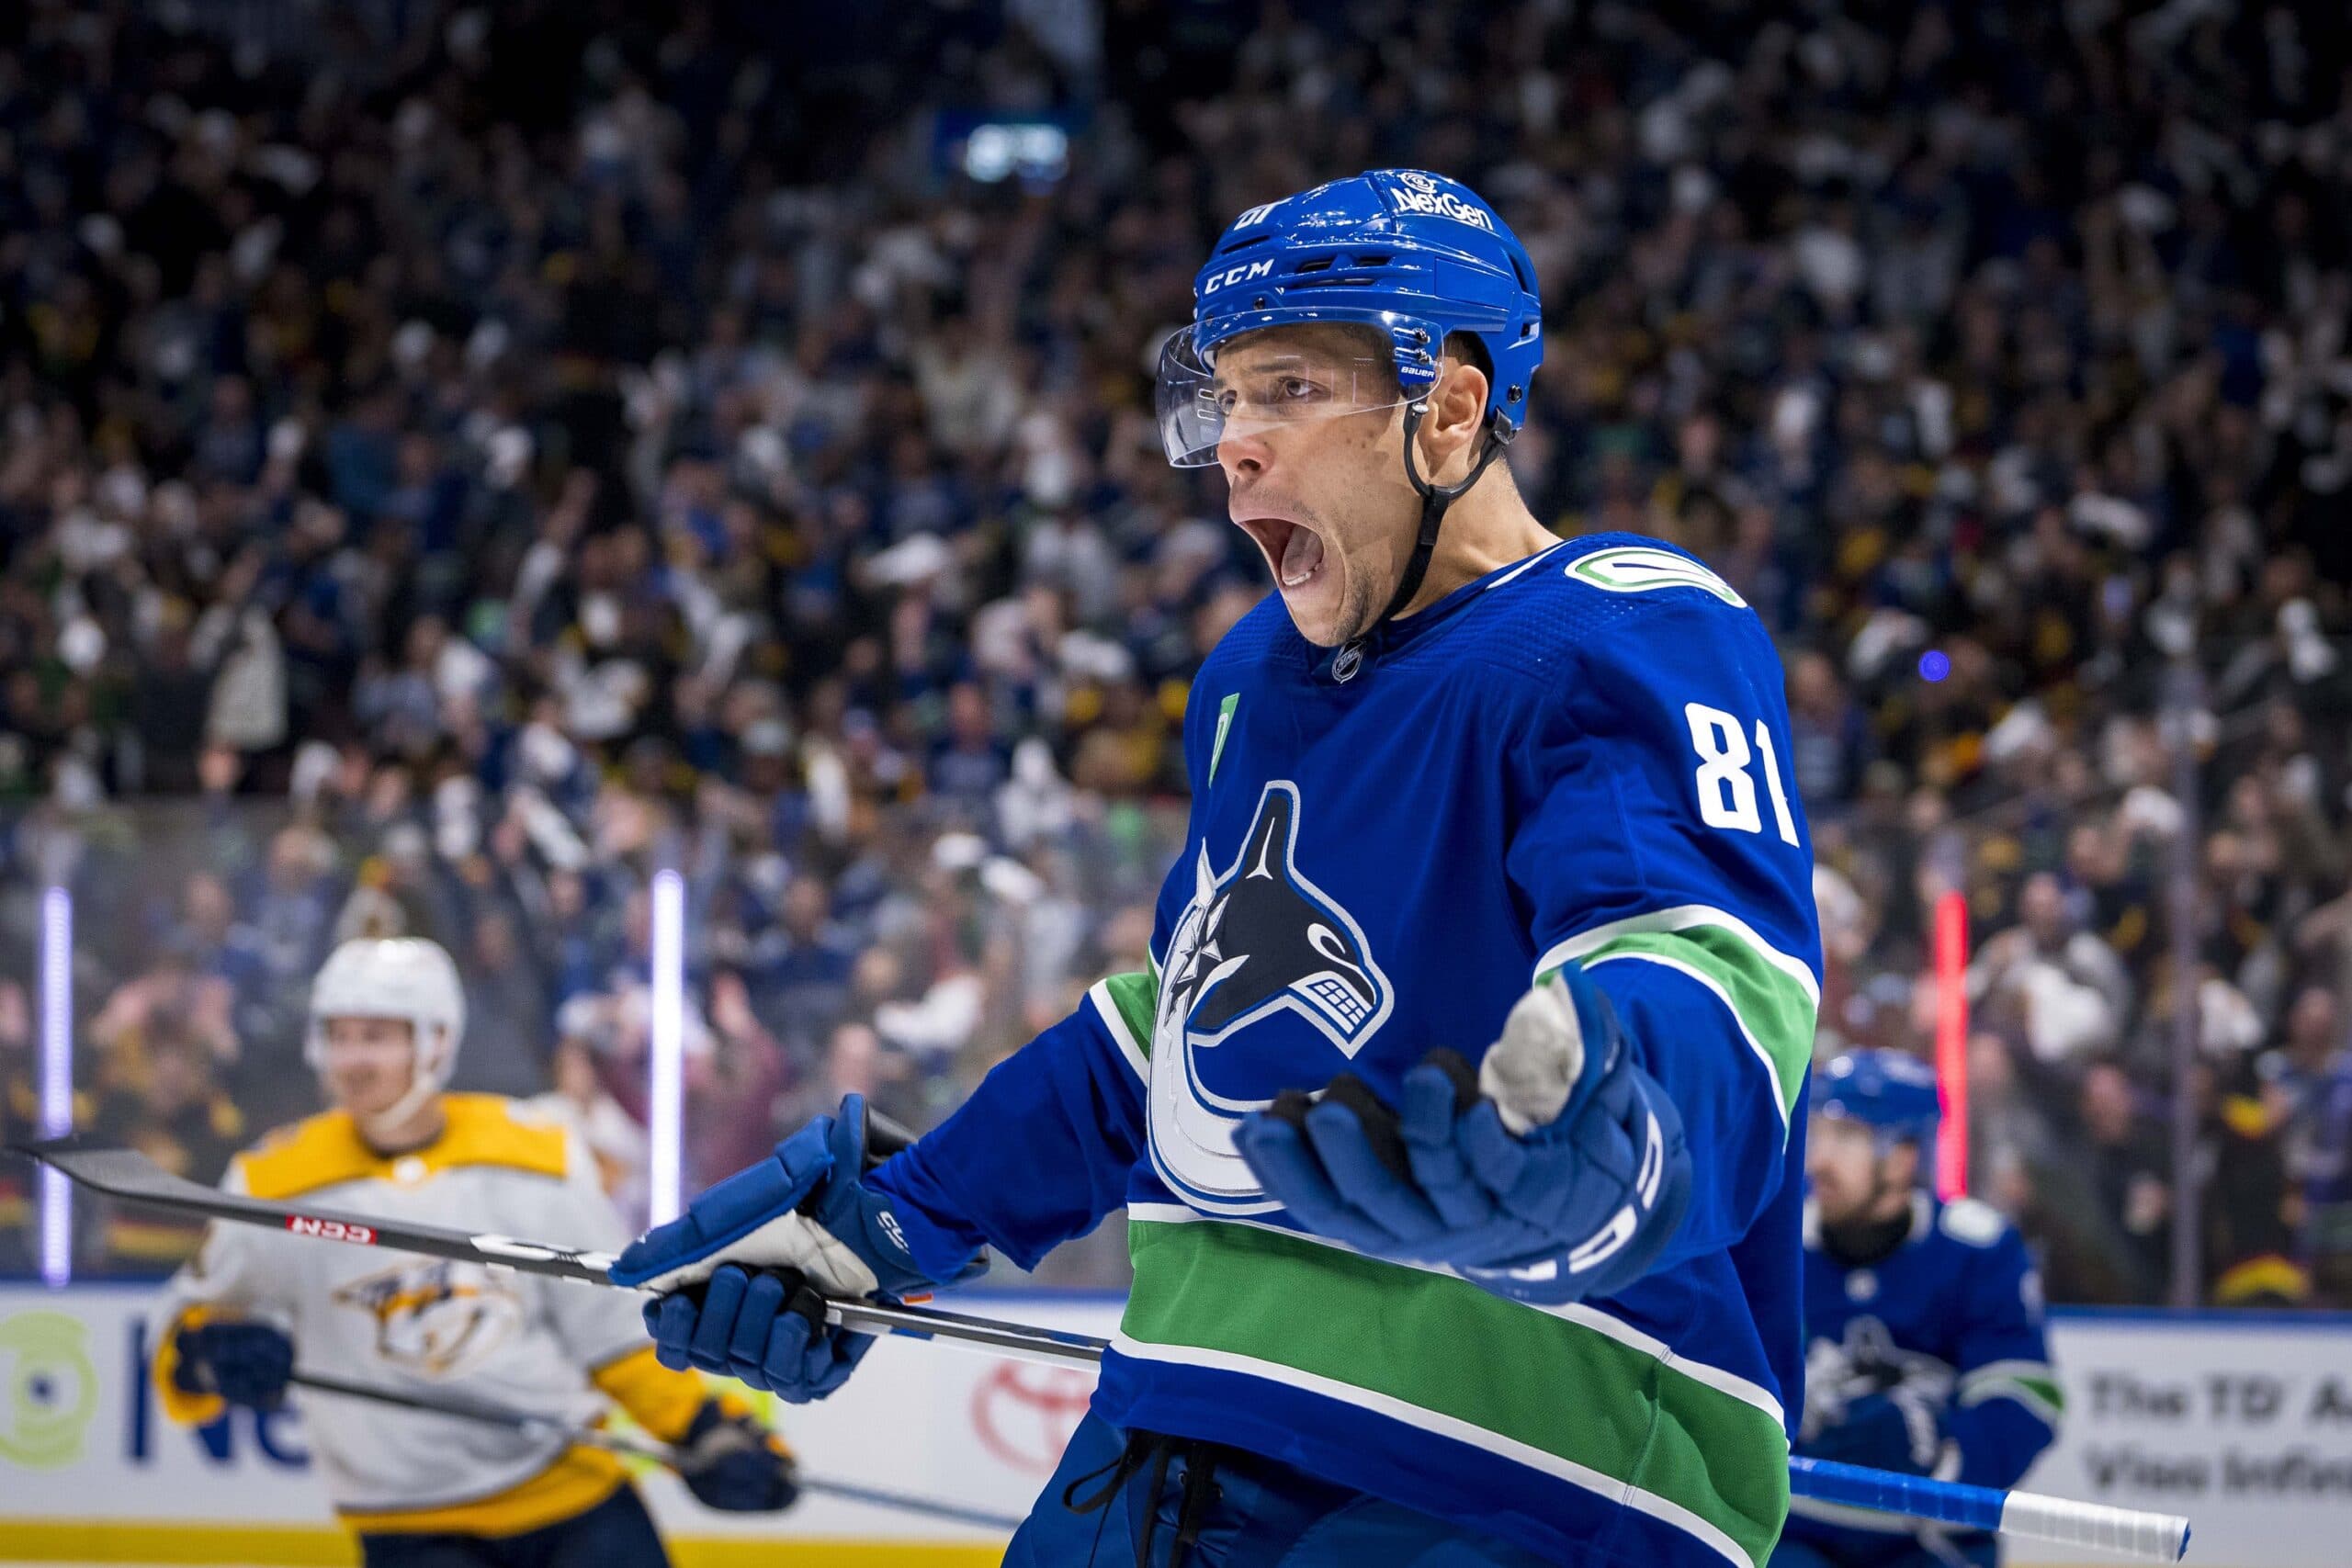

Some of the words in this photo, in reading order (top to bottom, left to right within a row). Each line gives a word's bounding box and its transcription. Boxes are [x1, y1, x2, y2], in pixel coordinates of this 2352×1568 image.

[1390, 187, 1493, 231] NexGen
[1204, 258, 1274, 295] CCM
[1685, 702, 1800, 848] 81
[292, 1216, 371, 1244] CCM
